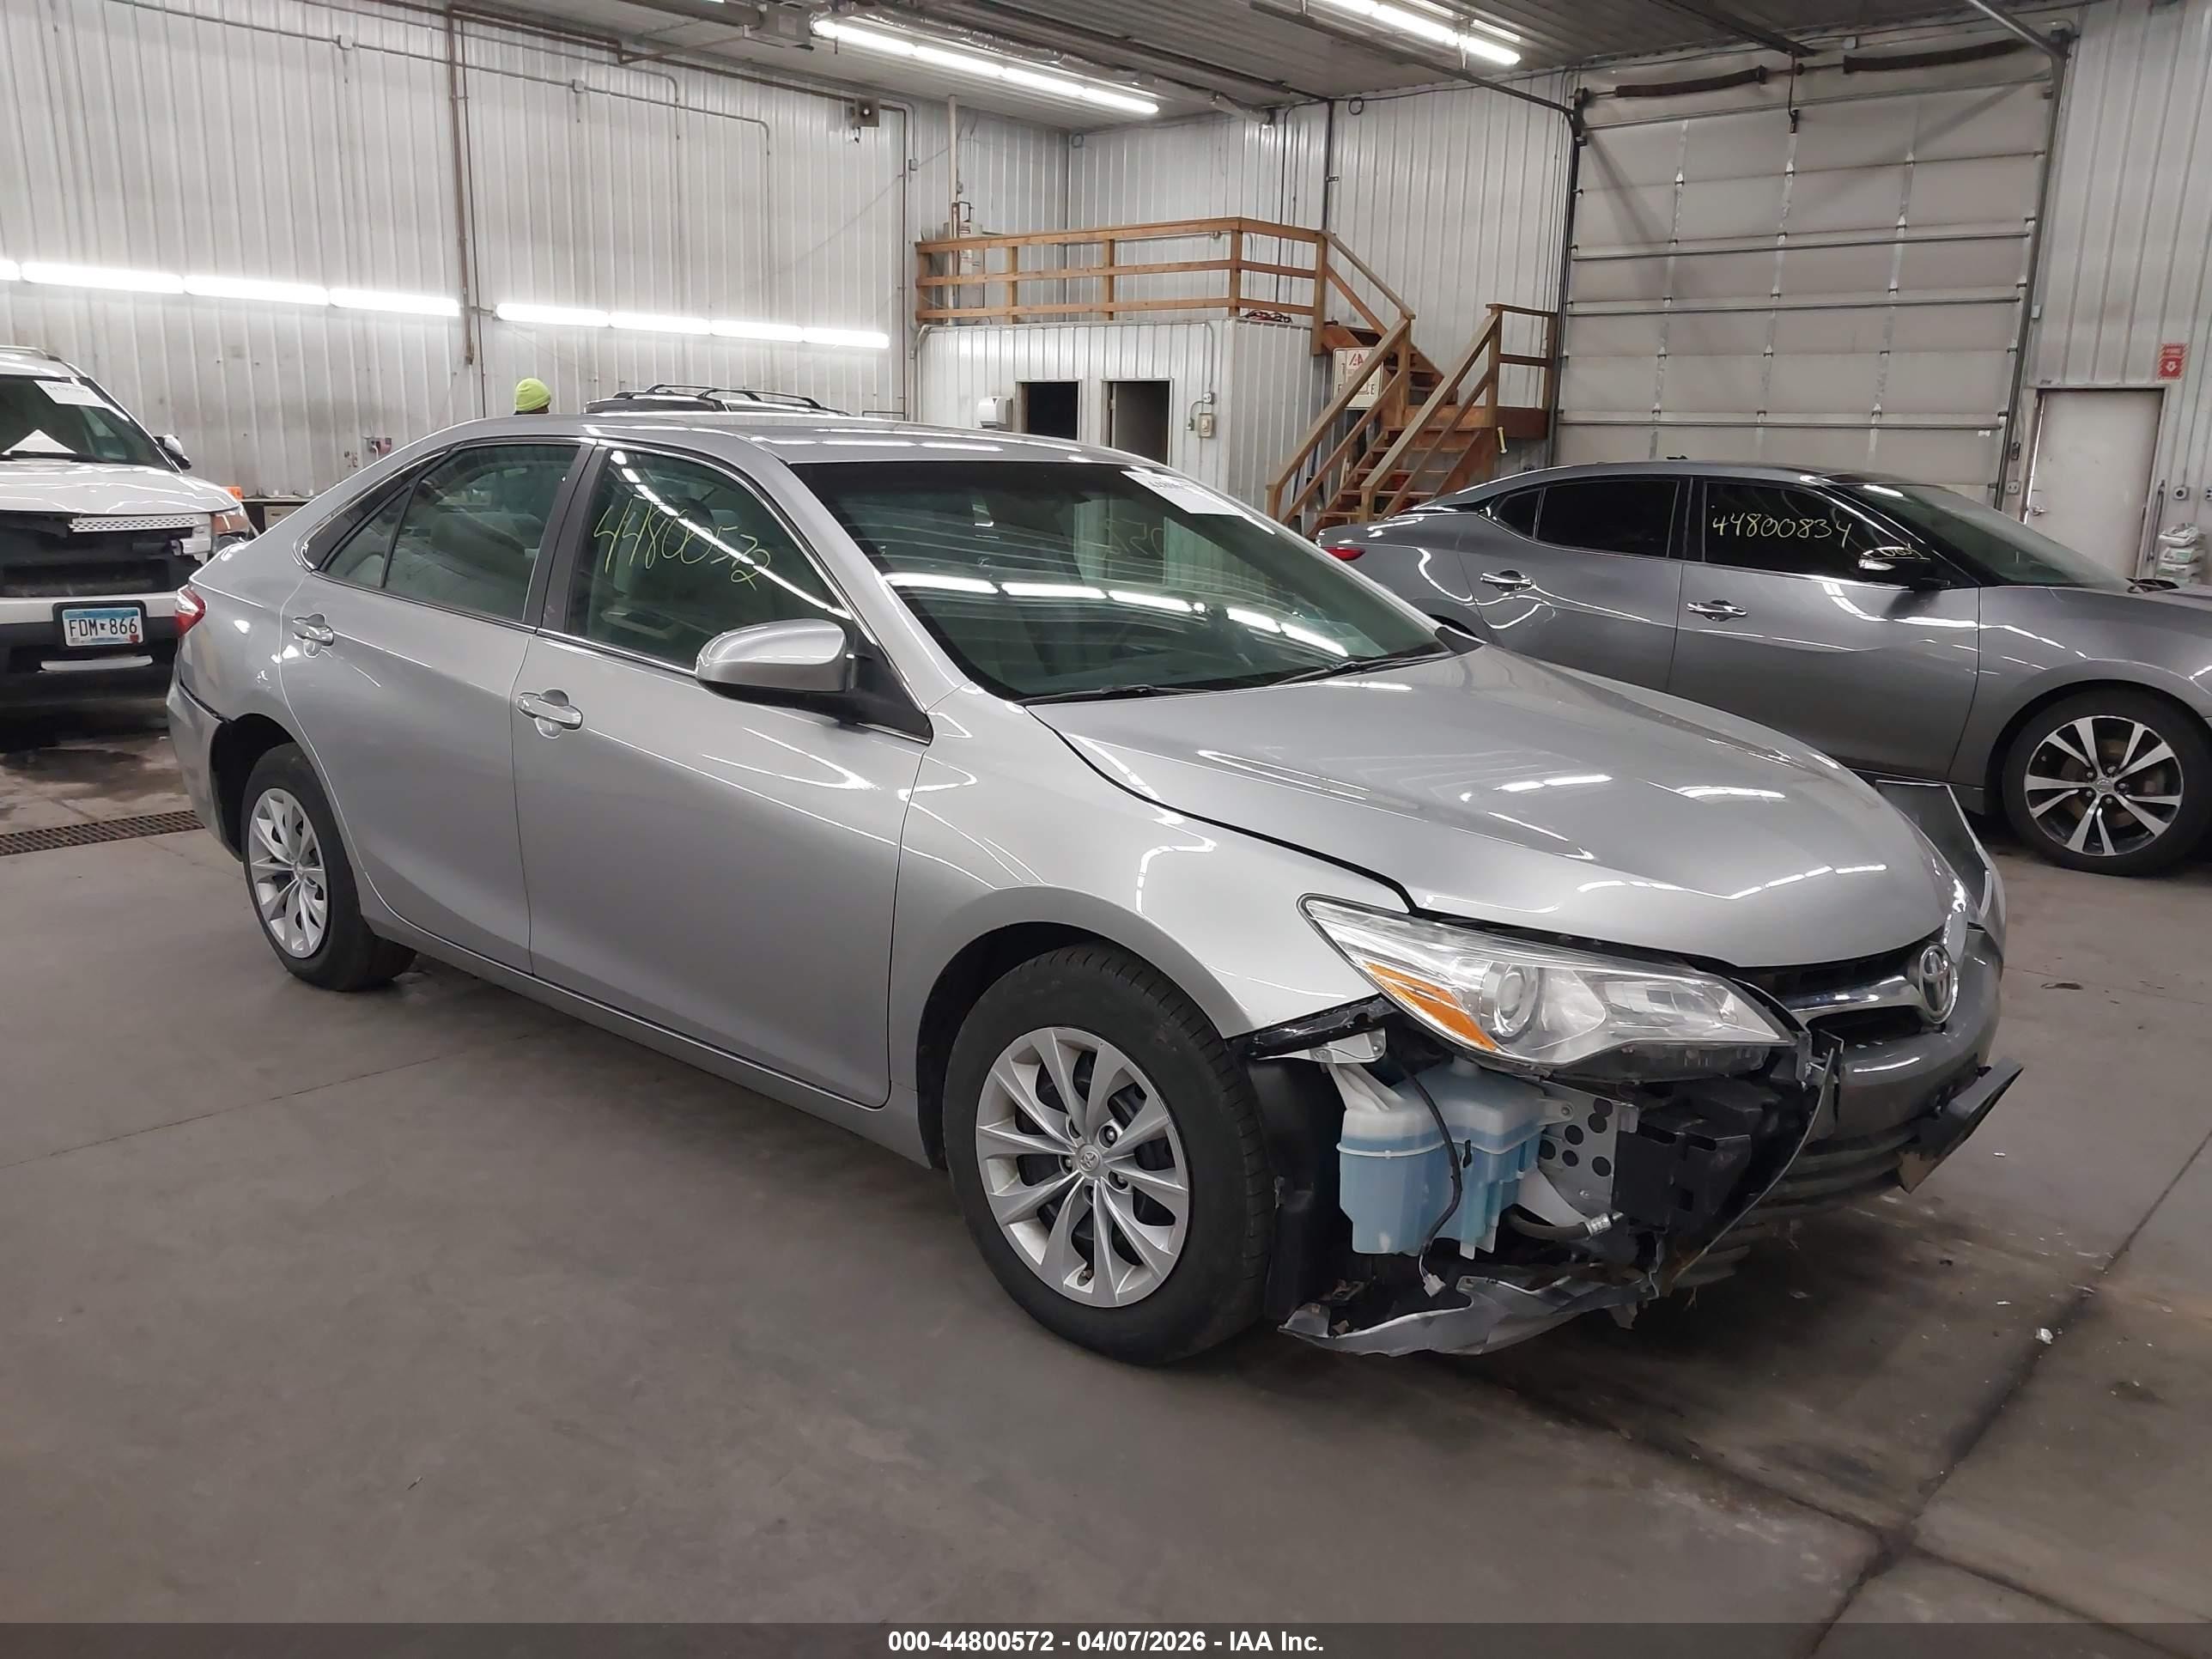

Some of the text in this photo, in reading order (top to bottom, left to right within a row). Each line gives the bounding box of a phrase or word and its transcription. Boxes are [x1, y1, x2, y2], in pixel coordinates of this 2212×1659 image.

[1712, 513, 1852, 548] 44800834
[69, 617, 137, 637] FDM 866
